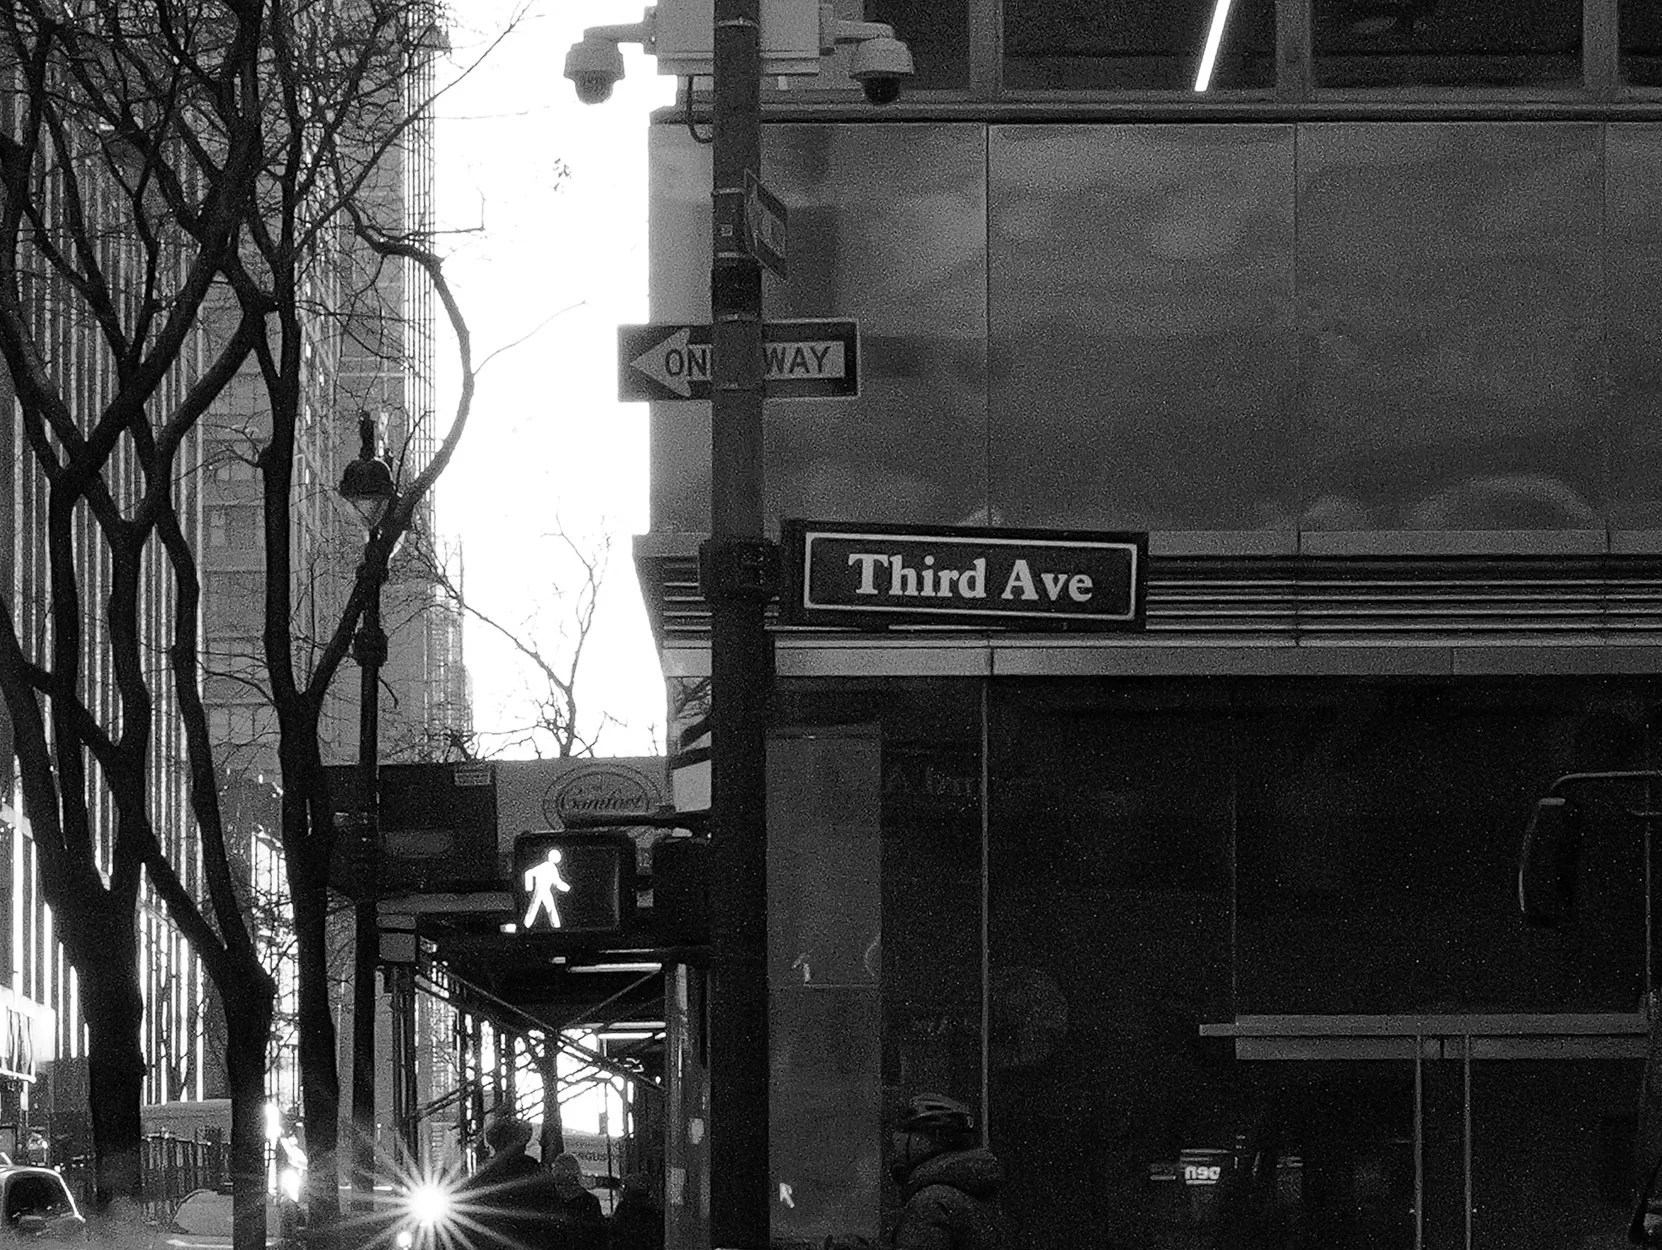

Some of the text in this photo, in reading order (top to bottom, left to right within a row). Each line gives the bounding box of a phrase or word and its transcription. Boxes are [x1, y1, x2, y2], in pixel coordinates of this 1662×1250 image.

[665, 345, 831, 377] ON WAY
[848, 554, 1093, 602] Third Ave
